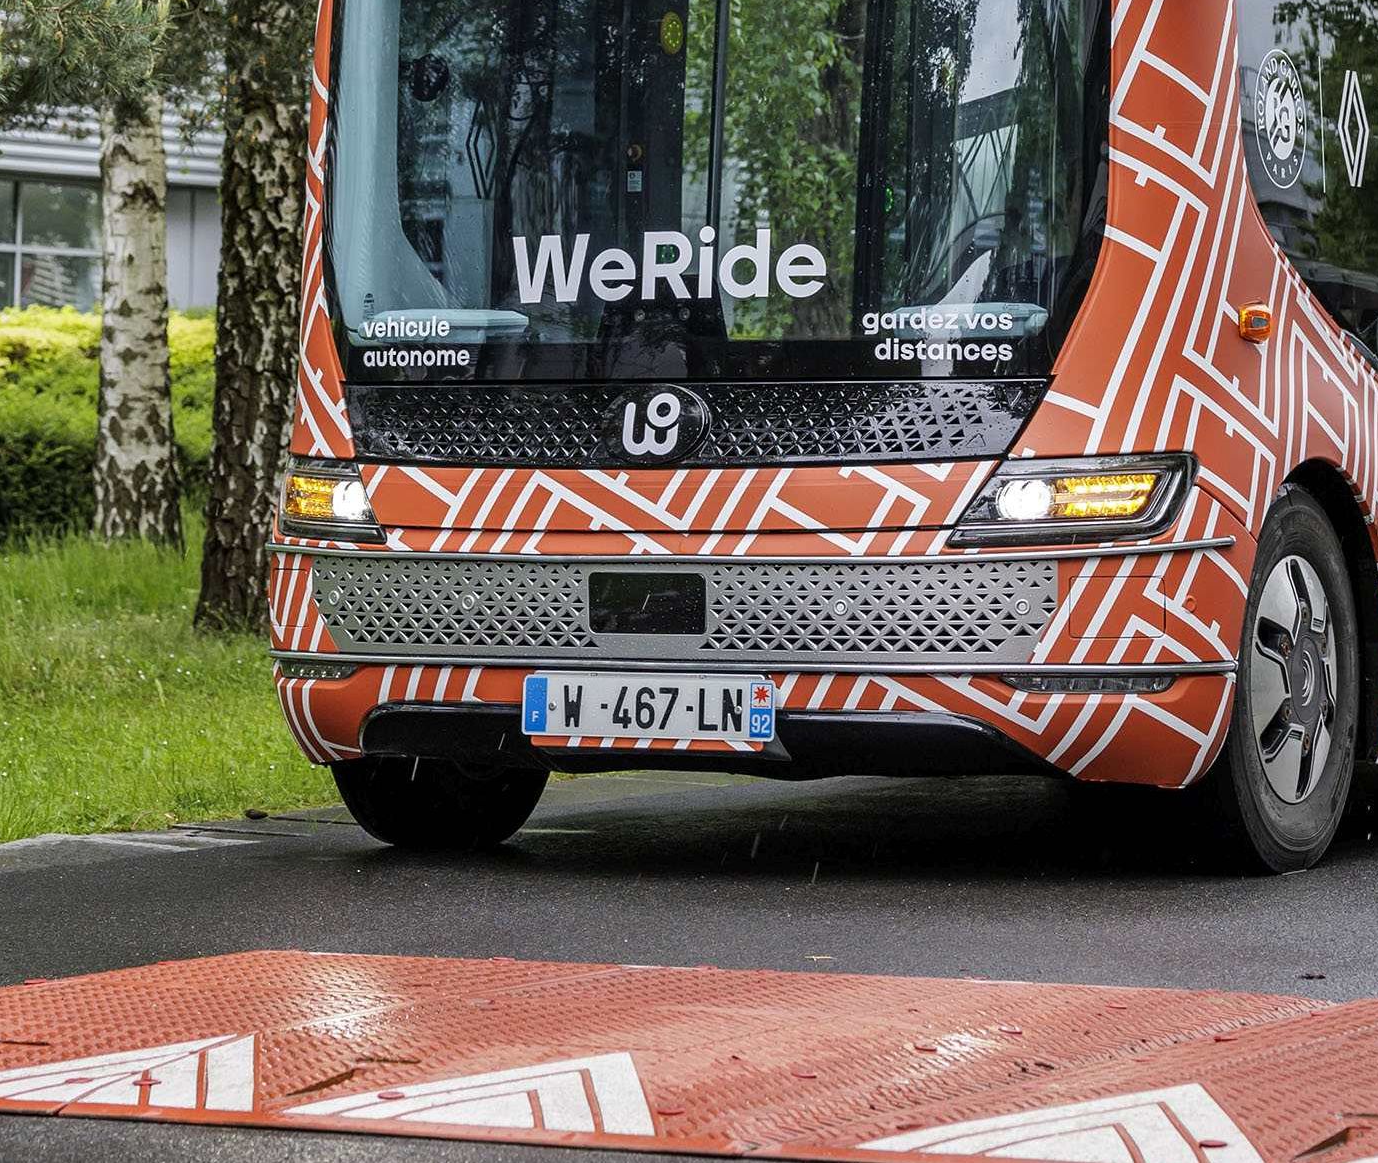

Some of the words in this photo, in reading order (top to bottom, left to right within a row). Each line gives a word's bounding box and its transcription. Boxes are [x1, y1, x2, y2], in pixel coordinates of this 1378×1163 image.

[1257, 57, 1278, 131] ROLAND
[1280, 59, 1304, 135] GARROS
[1266, 152, 1299, 178] PARIS
[512, 225, 827, 304] WeRide
[862, 308, 958, 335] gardez
[964, 312, 1013, 330] vos
[363, 348, 470, 367] autonome
[875, 338, 1013, 361] distances
[532, 711, 539, 722] F
[752, 714, 770, 733] 92
